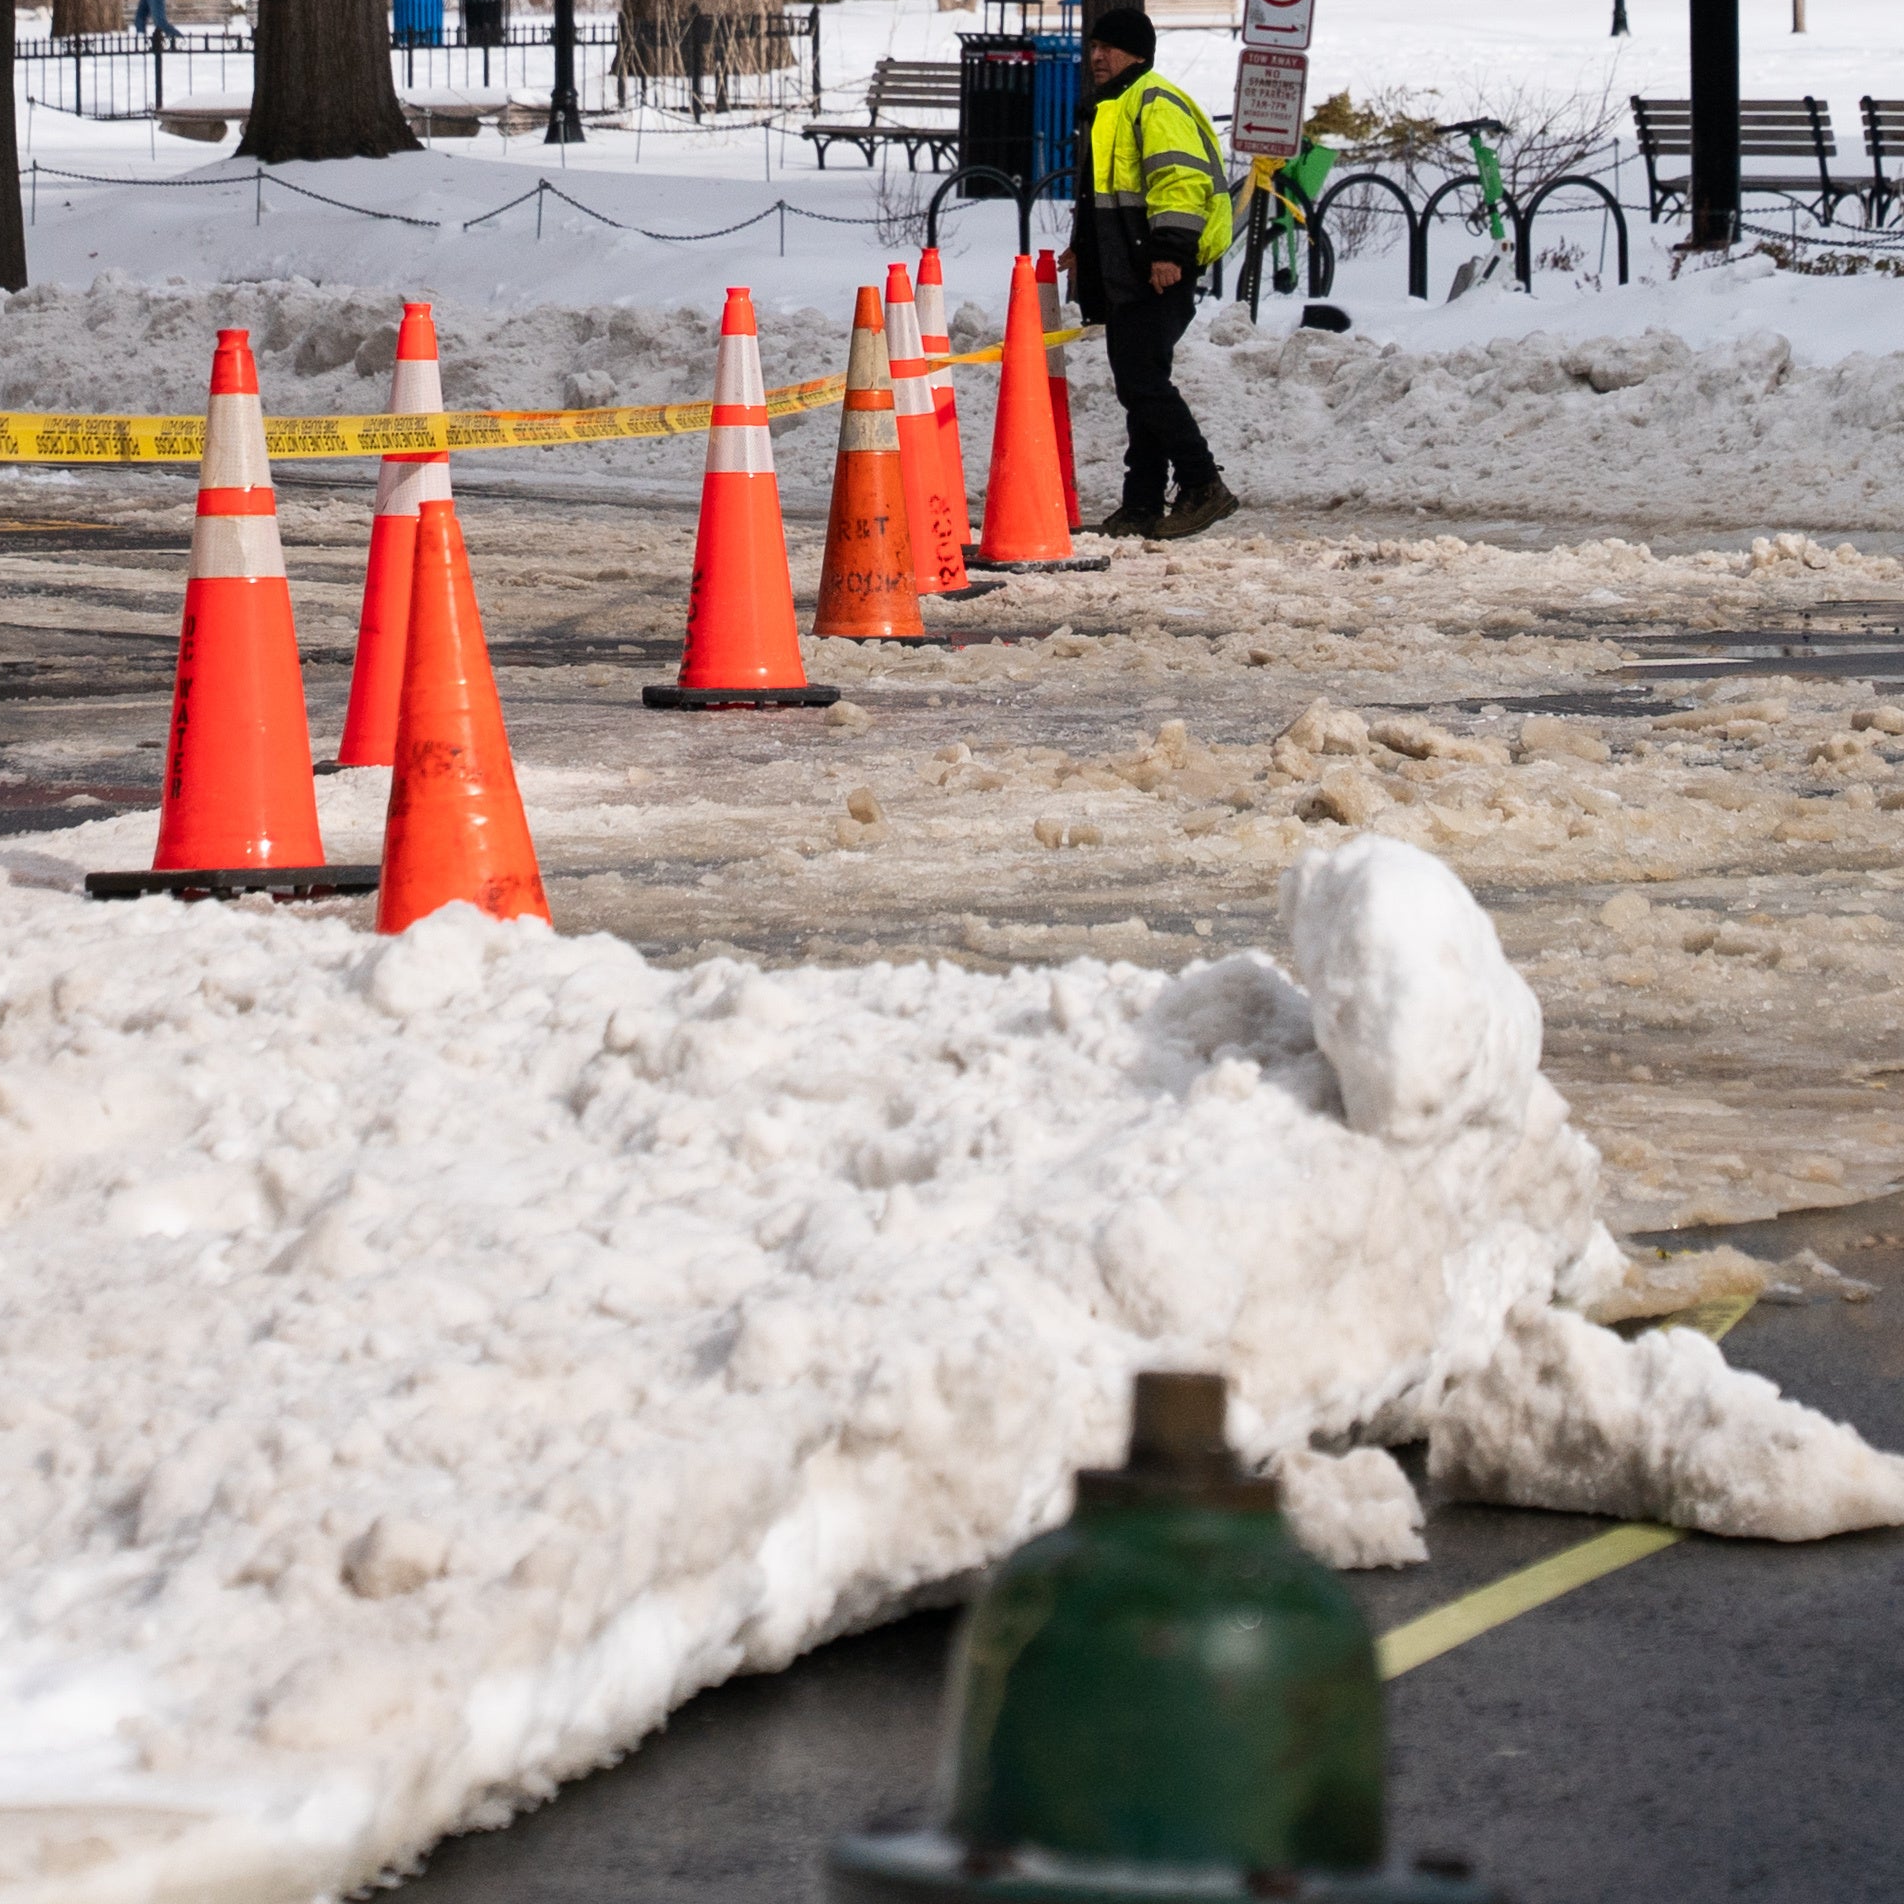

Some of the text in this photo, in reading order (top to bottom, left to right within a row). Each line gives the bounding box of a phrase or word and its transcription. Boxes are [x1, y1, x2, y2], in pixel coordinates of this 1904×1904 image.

[1249, 52, 1298, 68] TOW AWAY
[1265, 69, 1280, 78] NO
[1249, 77, 1295, 90] STANDING
[171, 678, 193, 799] WATER
